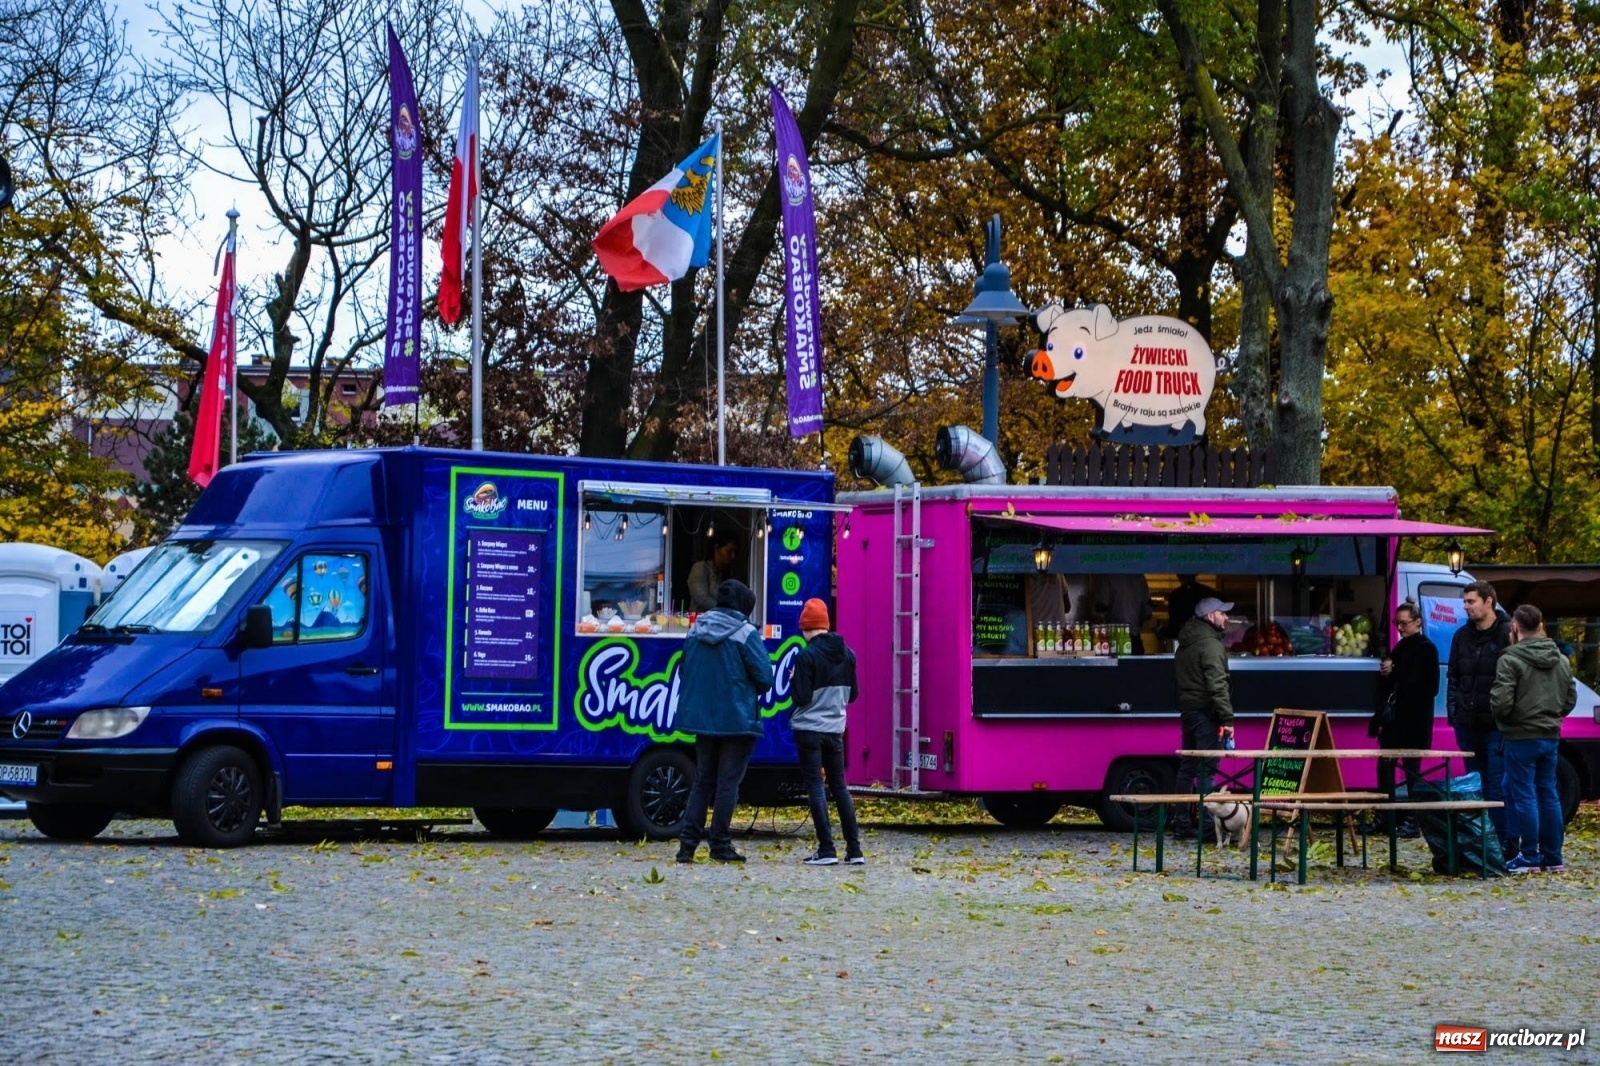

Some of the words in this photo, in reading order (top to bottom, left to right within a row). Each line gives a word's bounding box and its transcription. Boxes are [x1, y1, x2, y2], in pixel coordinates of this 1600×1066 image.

[1134, 324, 1153, 335] Jedz
[1157, 324, 1189, 338] śmiało!
[1130, 344, 1188, 366] ŻYWIECKI
[1114, 369, 1152, 394] FOOD
[1156, 370, 1202, 395] TRUCK
[1112, 398, 1138, 416] Bramy
[1140, 407, 1156, 418] raju
[1157, 409, 1167, 418] są
[1168, 401, 1201, 416] szerokie
[517, 499, 548, 511] MENU
[0, 624, 31, 639] TOI
[0, 639, 30, 655] TOI
[462, 703, 542, 712] WWW.SMAKOBAO.PL
